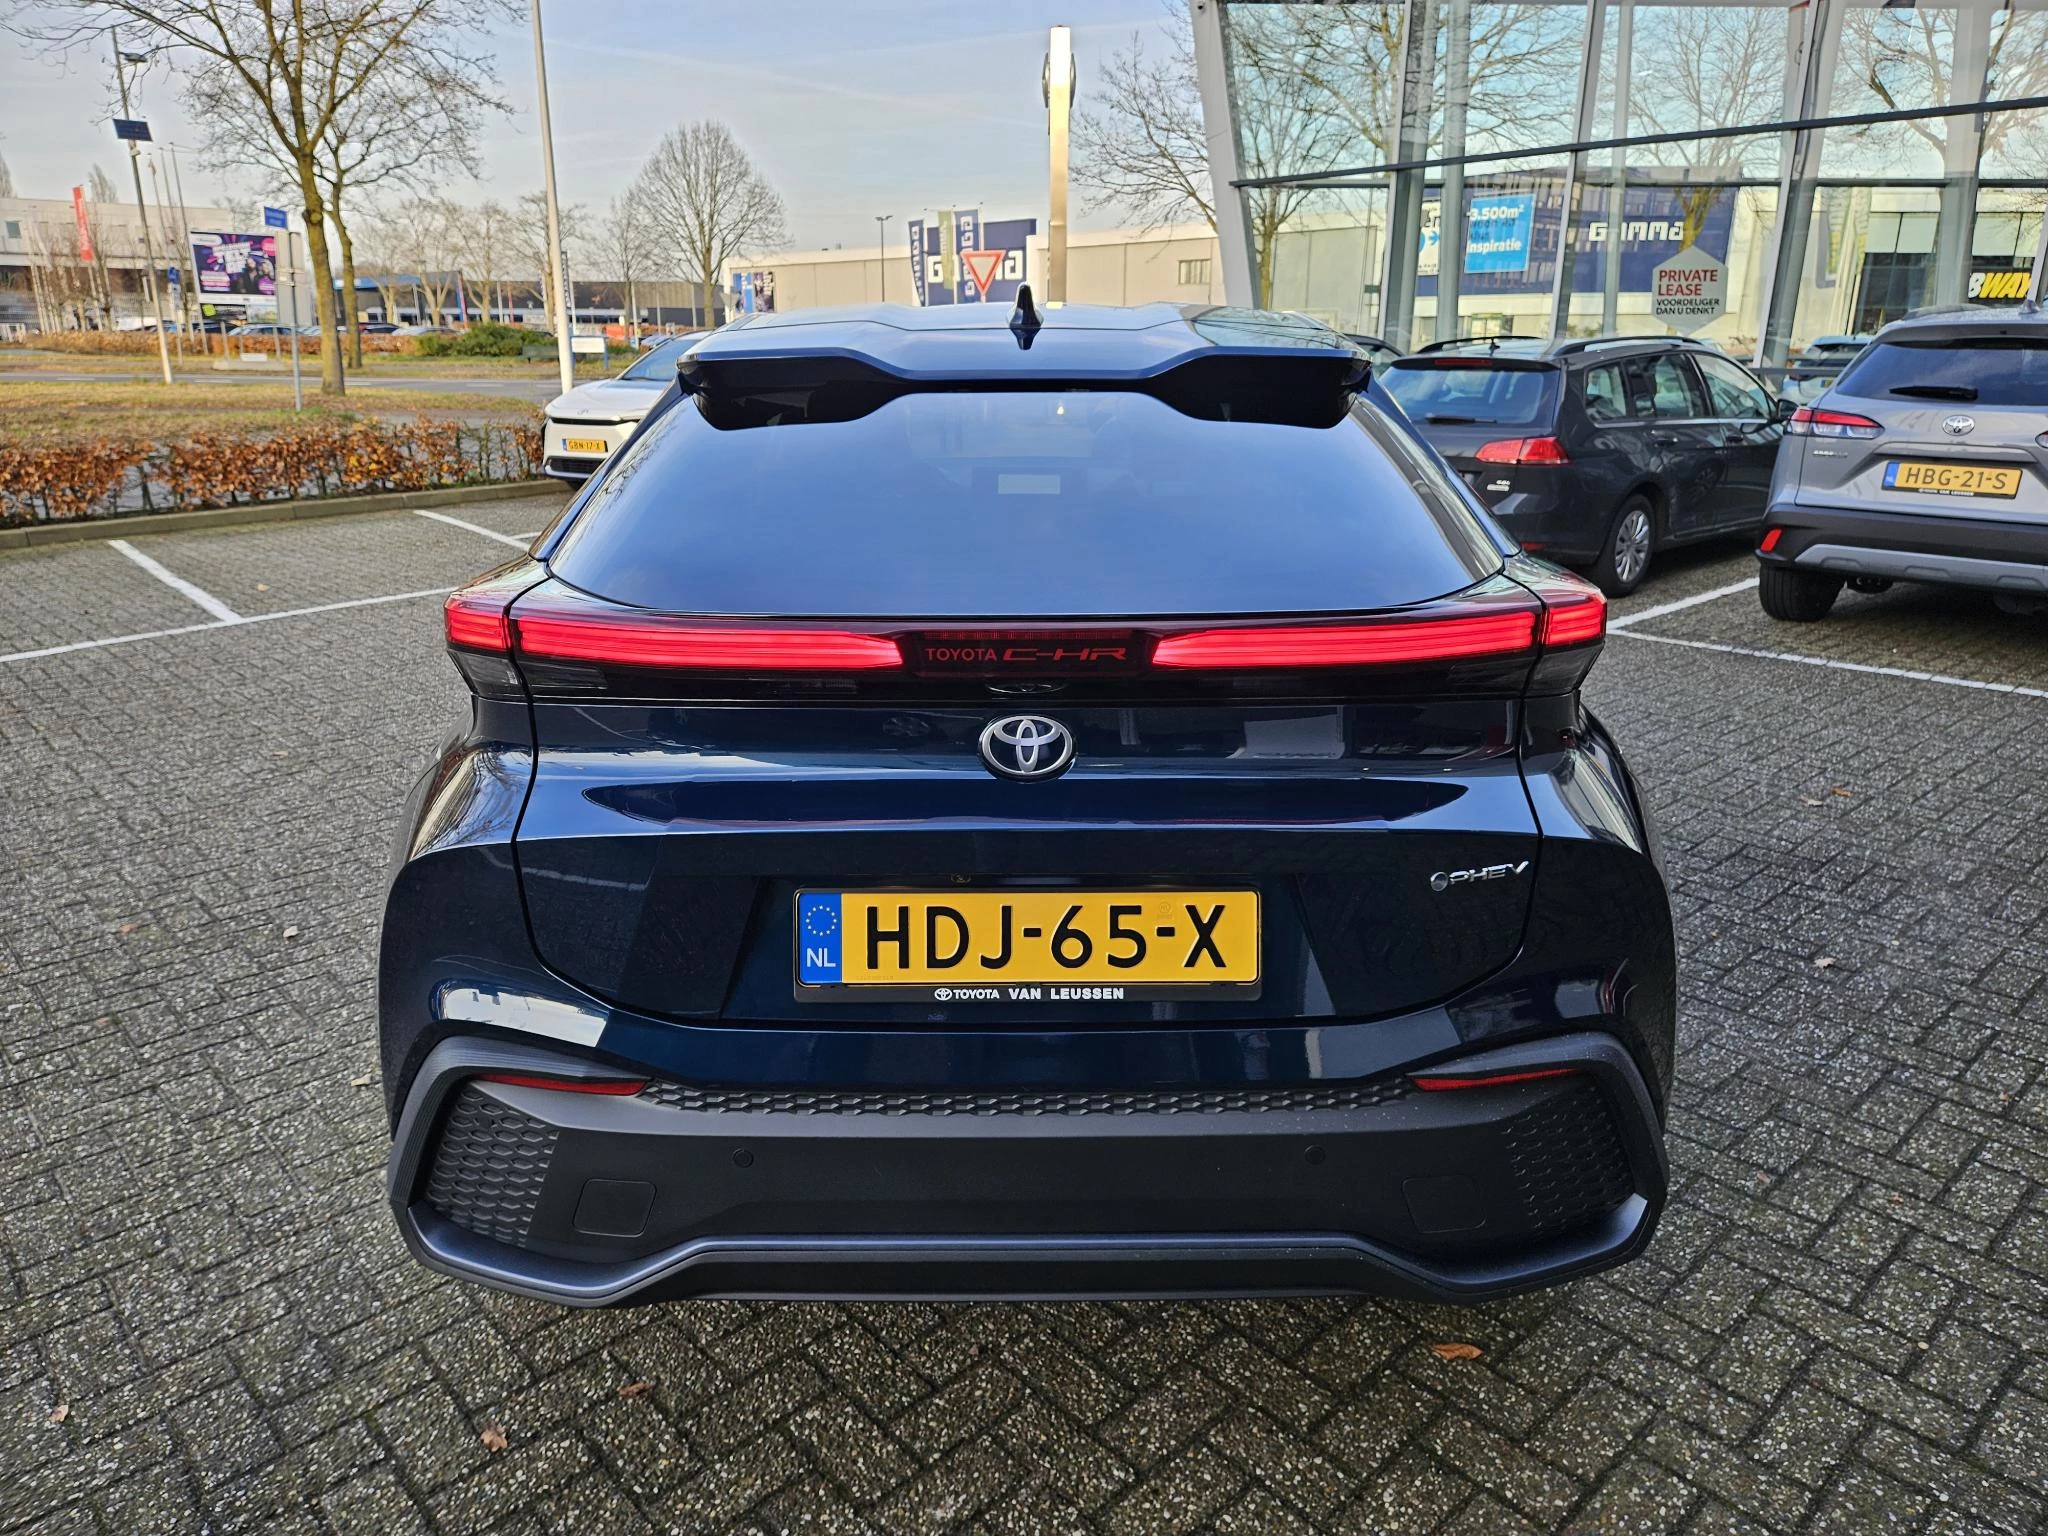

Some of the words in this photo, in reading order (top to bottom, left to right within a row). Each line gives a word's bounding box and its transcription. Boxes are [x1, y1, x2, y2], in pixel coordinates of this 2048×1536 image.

[1658, 269, 1719, 283] PRIVATE
[1657, 283, 1703, 297] LEASE
[1967, 272, 2032, 299] BWAY
[1656, 298, 1721, 307] VOORDELIGER
[1656, 307, 1675, 316] DAN
[1677, 307, 1684, 316] U
[1685, 307, 1716, 316] DENKT
[1905, 467, 2008, 490] HBG-21-S
[926, 648, 997, 661] TOYOTA
[1003, 648, 1126, 661] C-HR
[1449, 860, 1529, 885] PHEV
[806, 948, 836, 968] NL
[866, 904, 1227, 970] HDJ-65-X
[953, 988, 1000, 1000] TOYOTA
[1008, 988, 1041, 1000] VAN
[1050, 988, 1124, 1000] LEUSSEN
